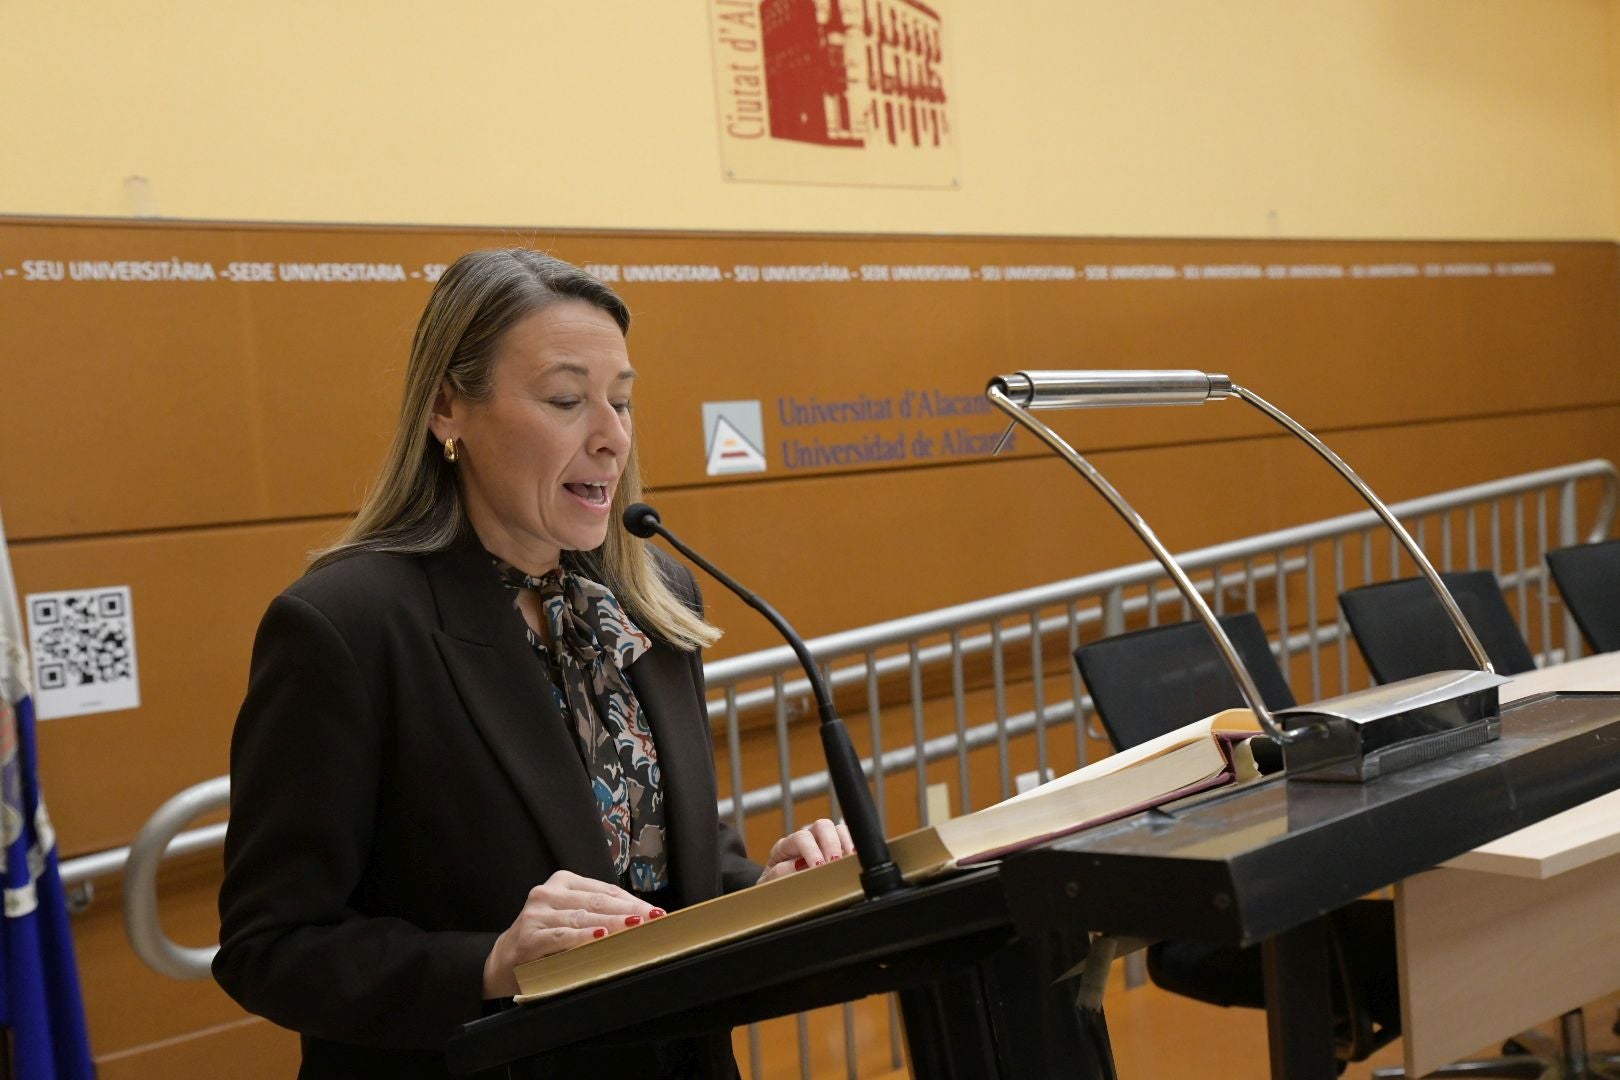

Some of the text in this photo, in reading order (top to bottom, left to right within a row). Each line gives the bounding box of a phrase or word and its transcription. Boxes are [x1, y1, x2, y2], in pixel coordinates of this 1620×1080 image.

[725, 64, 765, 140] Ciutat
[22, 260, 65, 281] SEU
[68, 256, 217, 281] UNIVERSITÀRIA
[278, 262, 407, 282] UNIVERSITARIA
[778, 394, 893, 427] Universitat
[782, 432, 906, 469] Universidad
[911, 431, 934, 458] de
